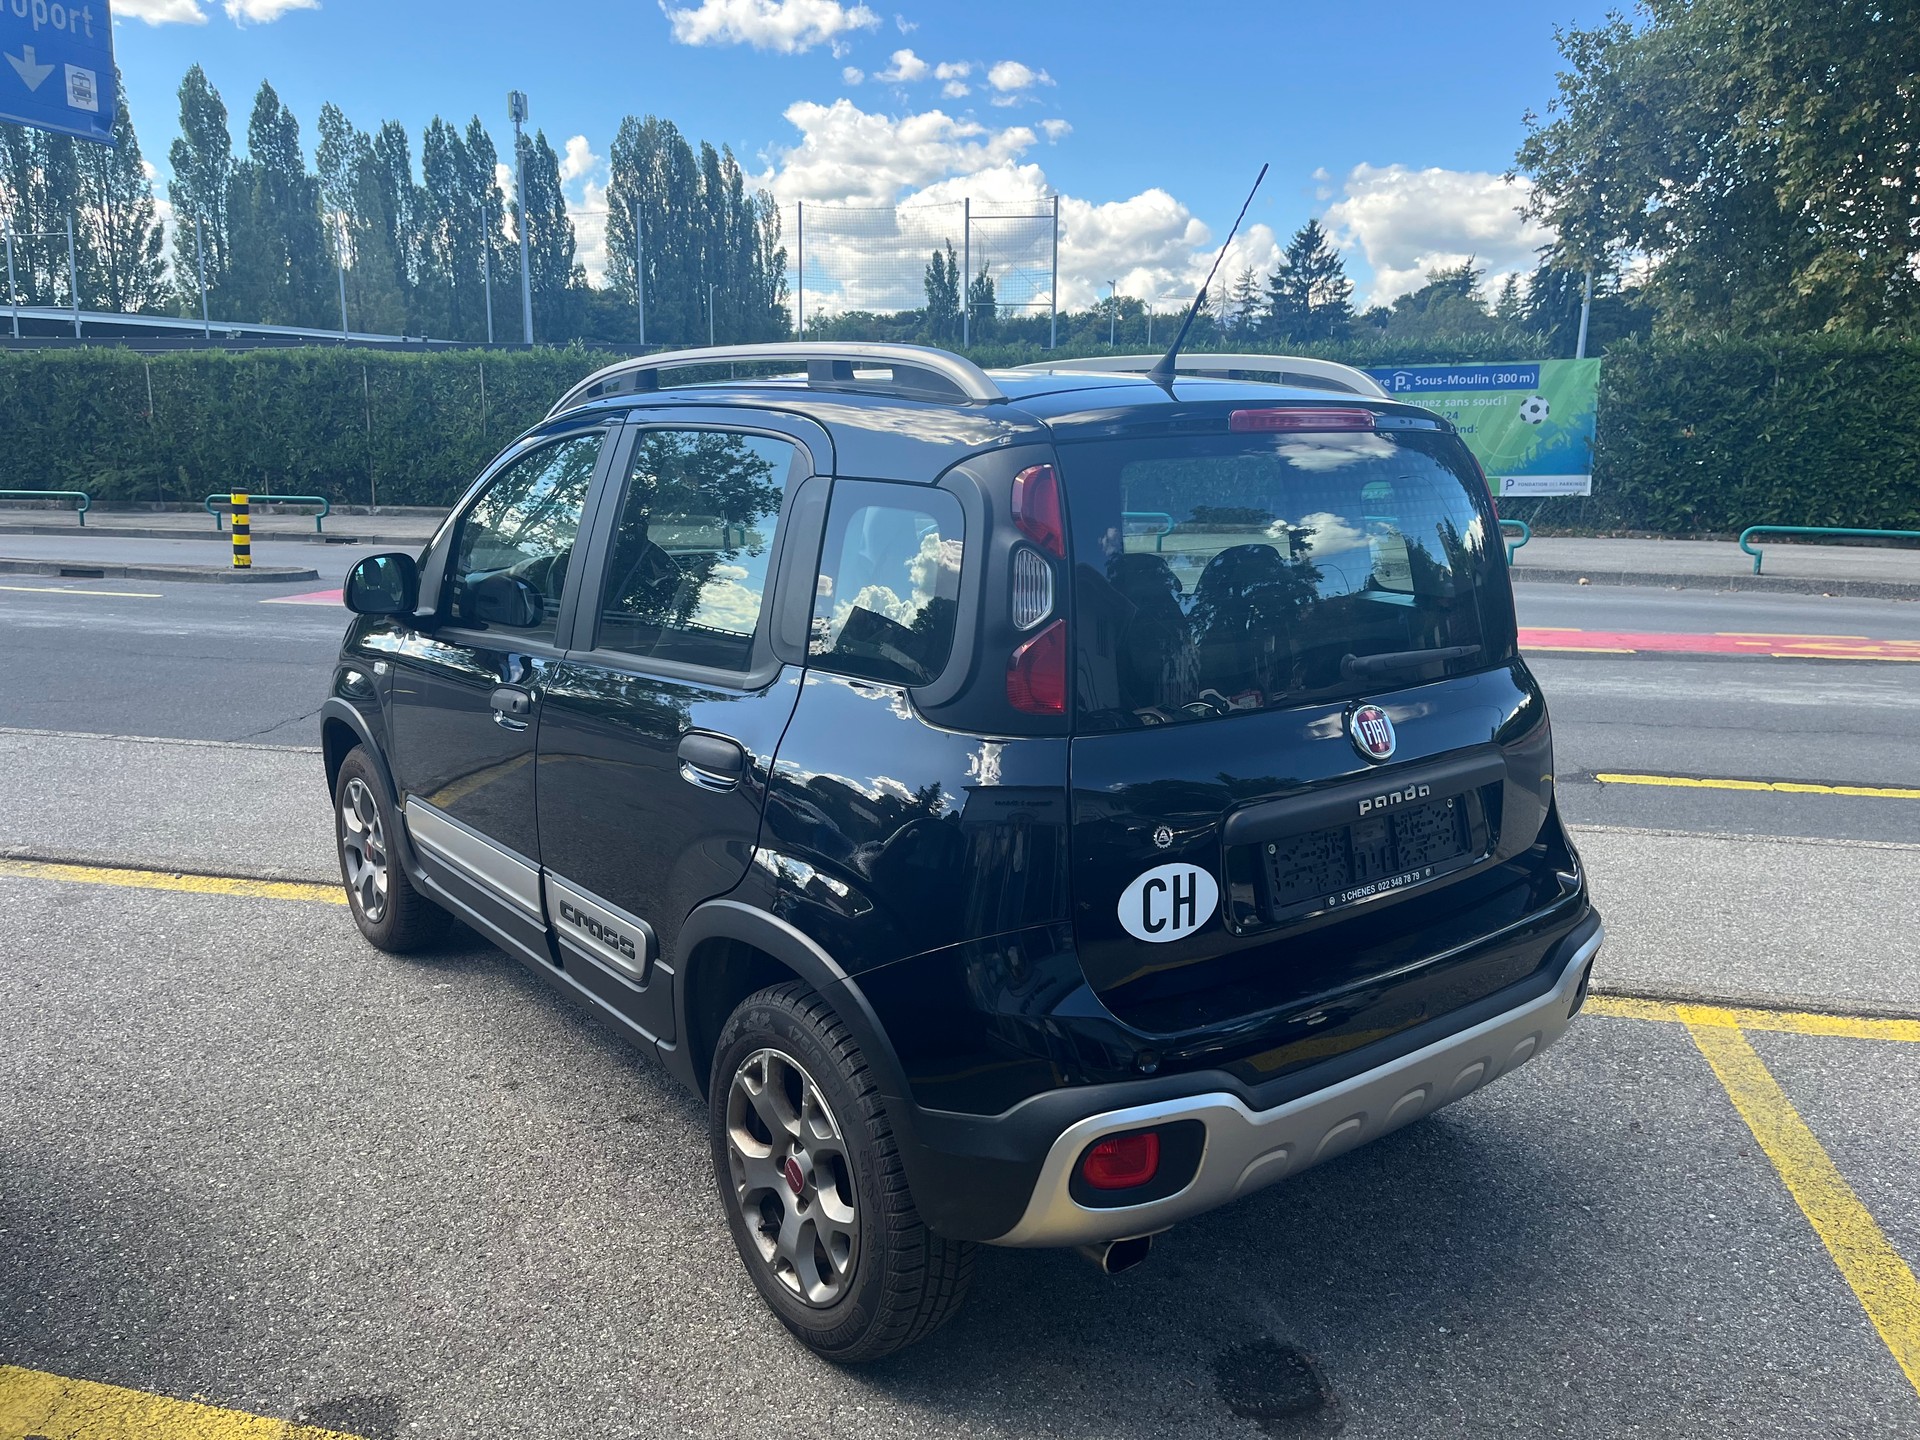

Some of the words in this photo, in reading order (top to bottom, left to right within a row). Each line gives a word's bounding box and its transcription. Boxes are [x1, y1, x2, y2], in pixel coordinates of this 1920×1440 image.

[0, 0, 94, 38] oport
[1415, 374, 1489, 386] Sous-Moulin
[1492, 373, 1517, 385] (300
[1519, 372, 1535, 384] m)
[1444, 398, 1469, 406] sans
[1361, 718, 1388, 745] FIAT
[1358, 783, 1431, 816] panda
[1341, 893, 1346, 902] 3
[1347, 885, 1376, 900] CHENES
[1377, 880, 1390, 891] 022
[1390, 876, 1403, 887] 348
[1412, 871, 1420, 880] 79
[1142, 872, 1196, 933] CH
